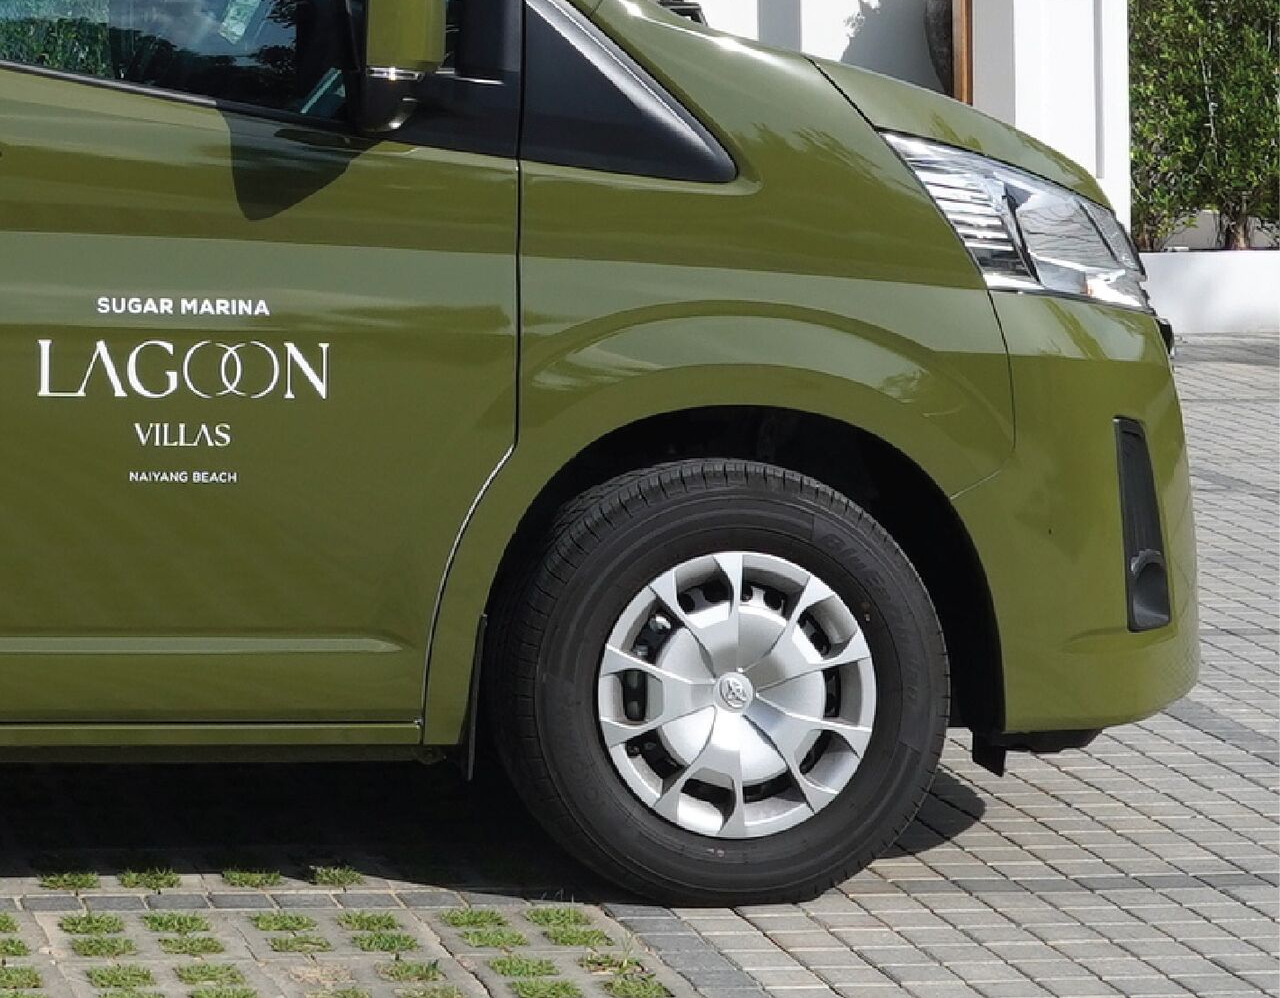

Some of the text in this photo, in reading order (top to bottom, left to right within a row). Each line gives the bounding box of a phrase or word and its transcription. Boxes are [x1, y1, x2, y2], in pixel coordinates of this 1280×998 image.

[96, 296, 270, 316] SUGAR MARINA
[37, 339, 330, 400] LAGOON
[134, 422, 232, 447] VILLAS
[128, 470, 238, 484] NAIYANG BEACH
